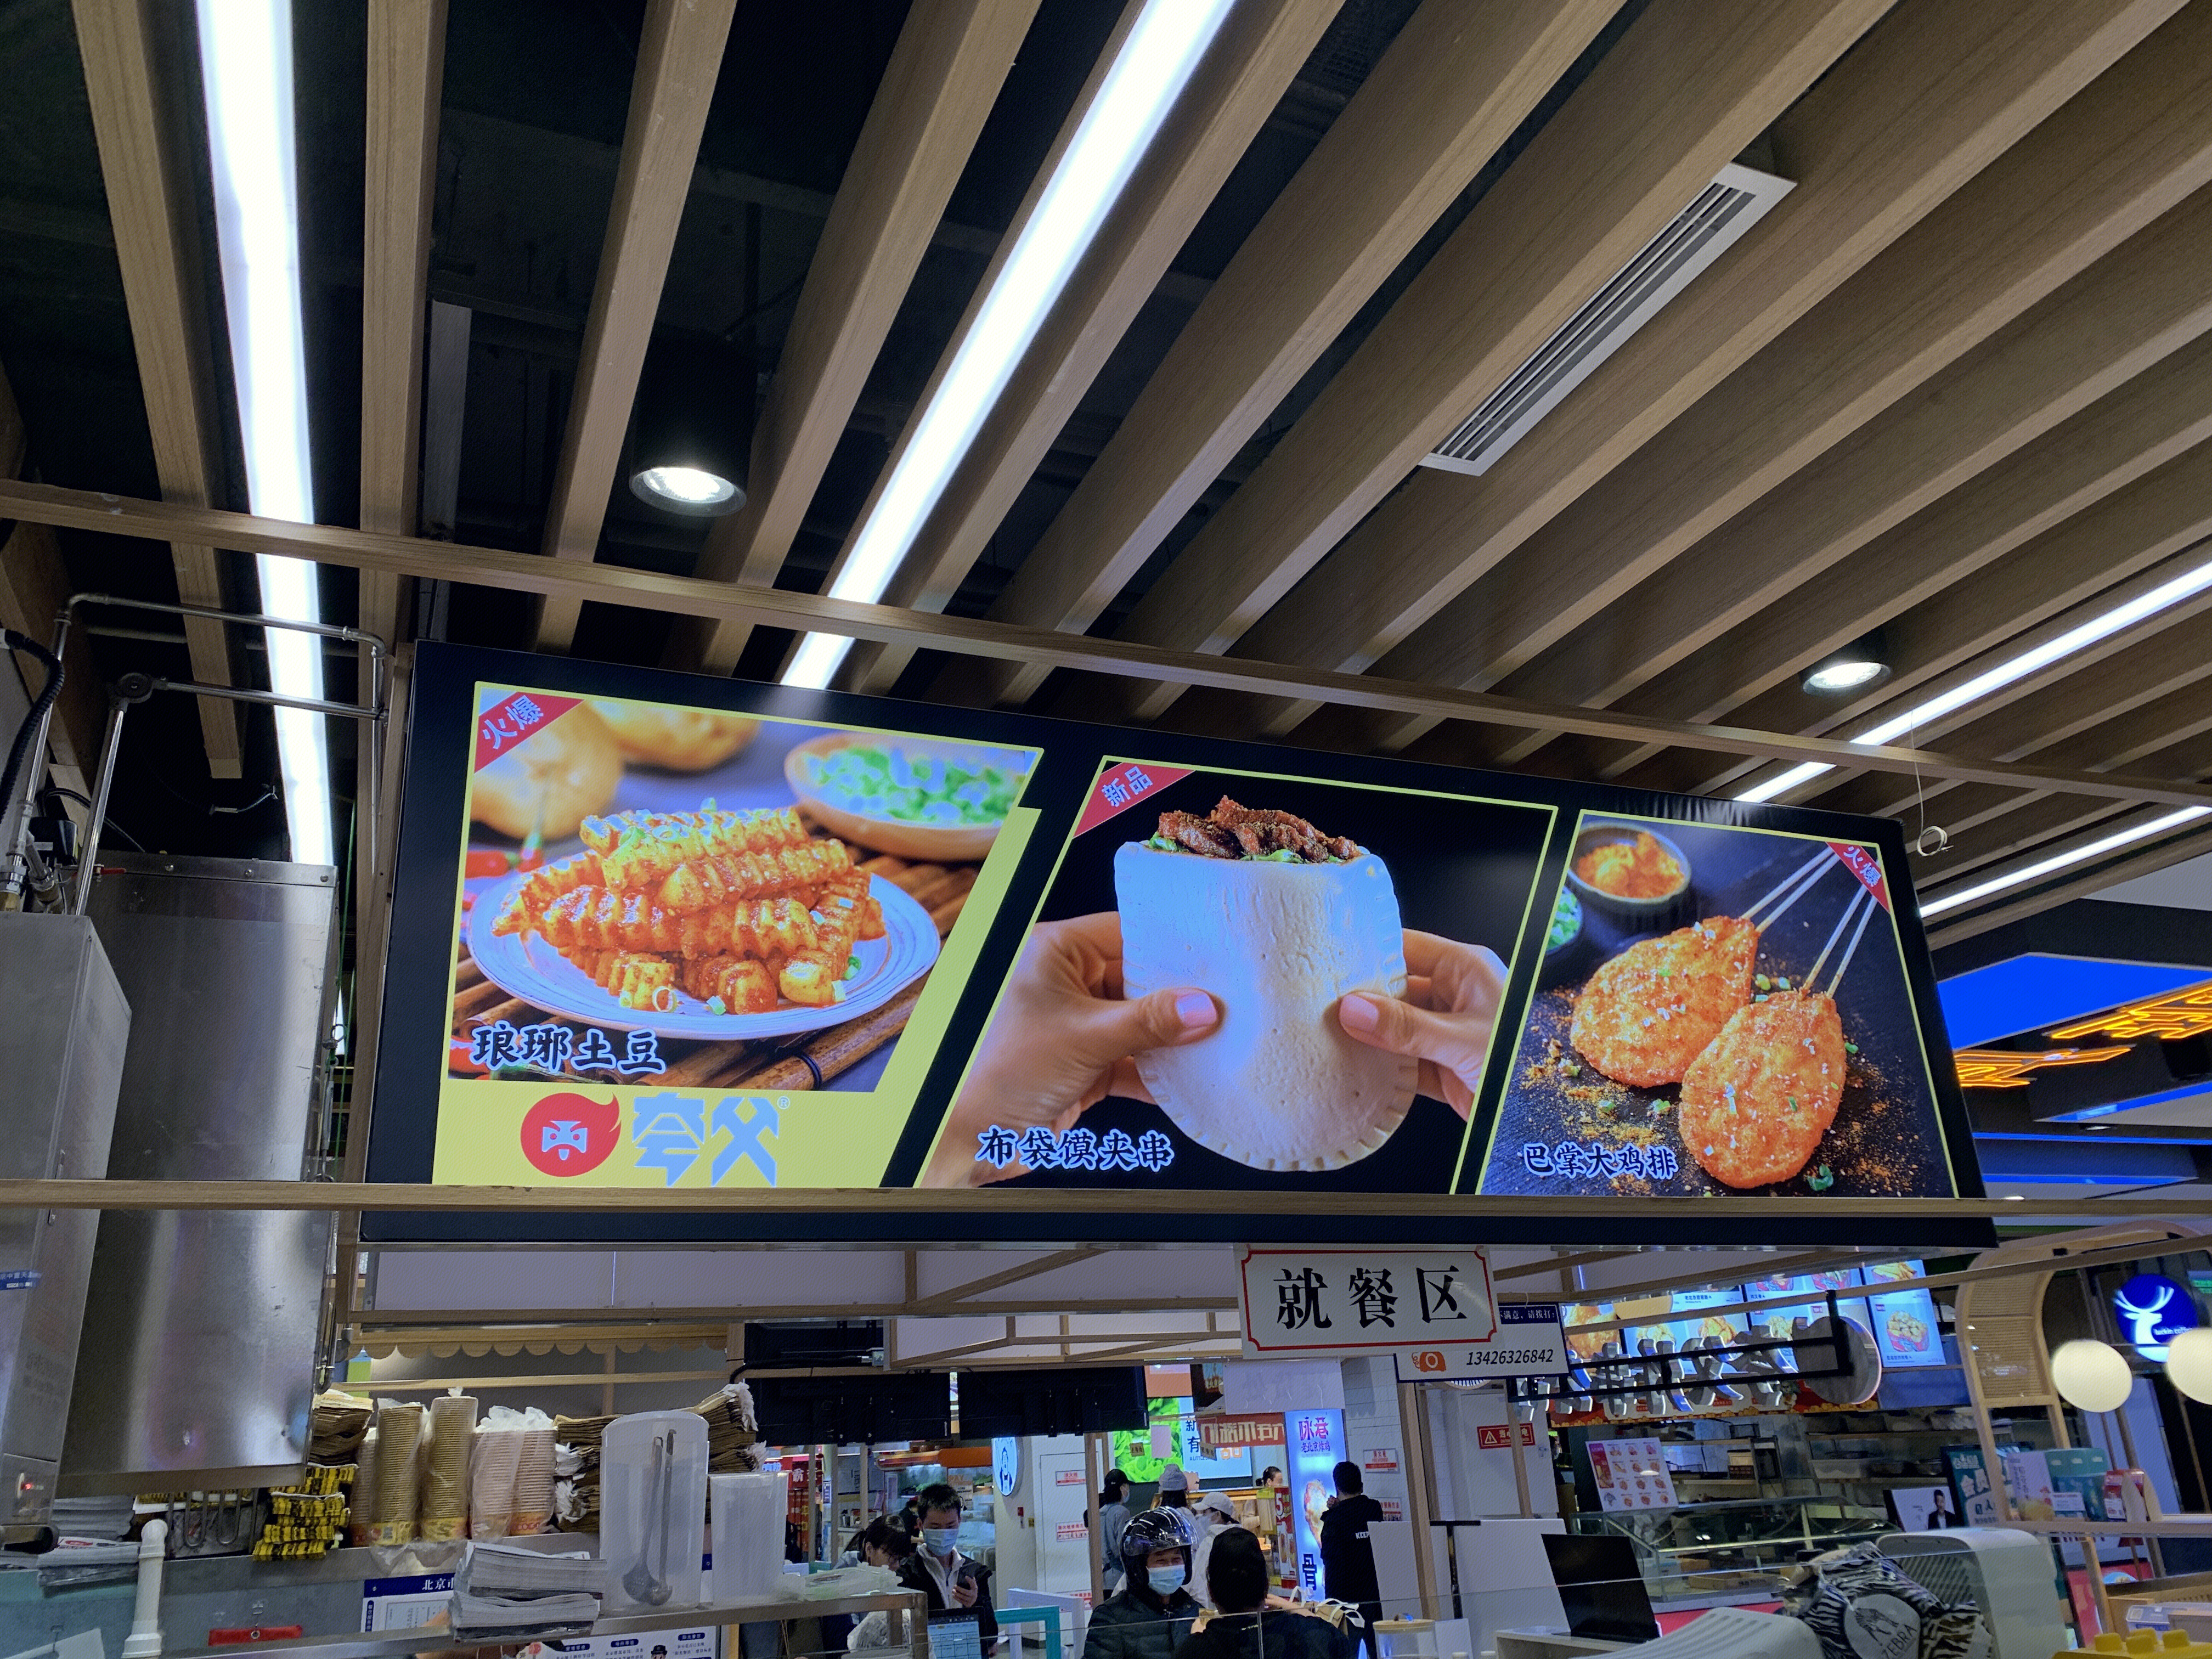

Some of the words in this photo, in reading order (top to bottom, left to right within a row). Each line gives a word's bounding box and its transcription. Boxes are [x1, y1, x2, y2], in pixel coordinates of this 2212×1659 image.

[482, 695, 545, 749] 火爆
[1102, 766, 1153, 808] 新品
[1843, 844, 1882, 888] 火爆
[471, 1021, 665, 1074] 琅琊土豆
[631, 1092, 780, 1188] 夸父
[975, 1124, 1174, 1172] 布袋馍夹串
[1522, 1141, 1677, 1181] 巴掌大鸡排
[1273, 1265, 1467, 1329] 就餐区
[1466, 1348, 1554, 1366] 13426326842
